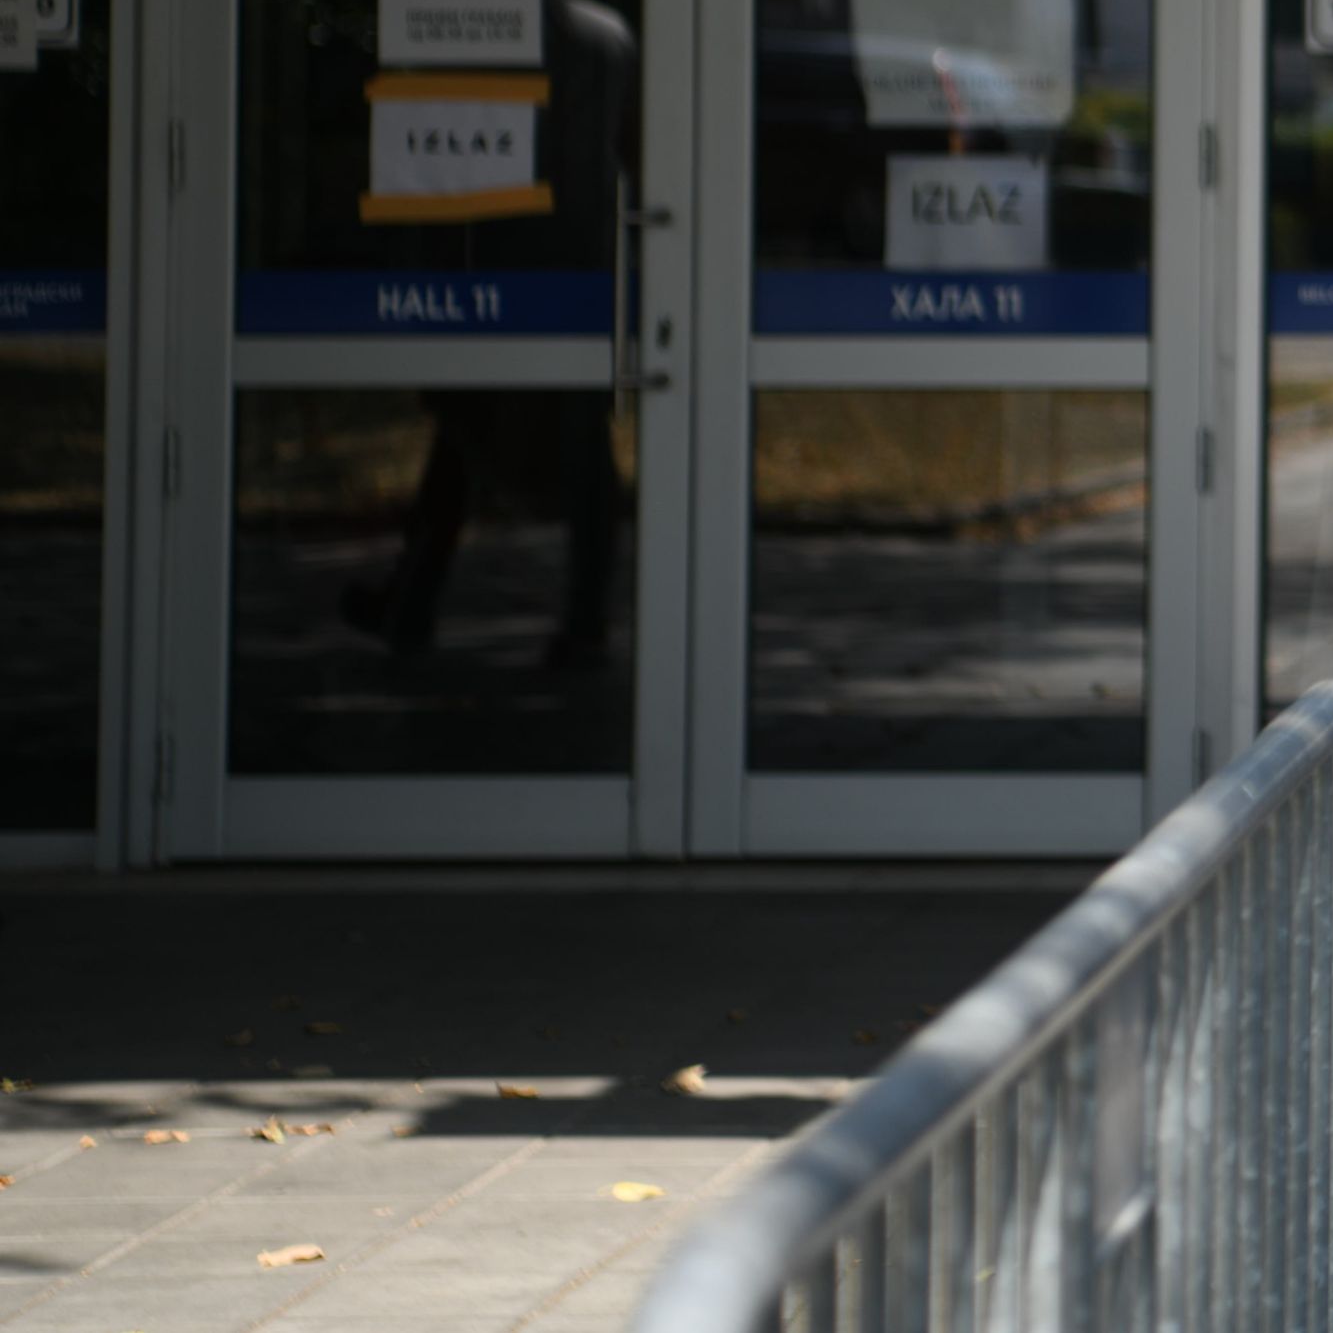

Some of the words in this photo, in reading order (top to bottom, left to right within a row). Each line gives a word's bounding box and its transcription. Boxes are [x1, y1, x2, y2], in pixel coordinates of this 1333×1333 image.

[405, 128, 515, 157] IZLAZ
[909, 182, 1025, 227] IZLAZ
[376, 285, 464, 321] HALL
[473, 284, 502, 321] 11
[890, 284, 986, 321] ХАЛА
[993, 284, 1025, 321] 11
